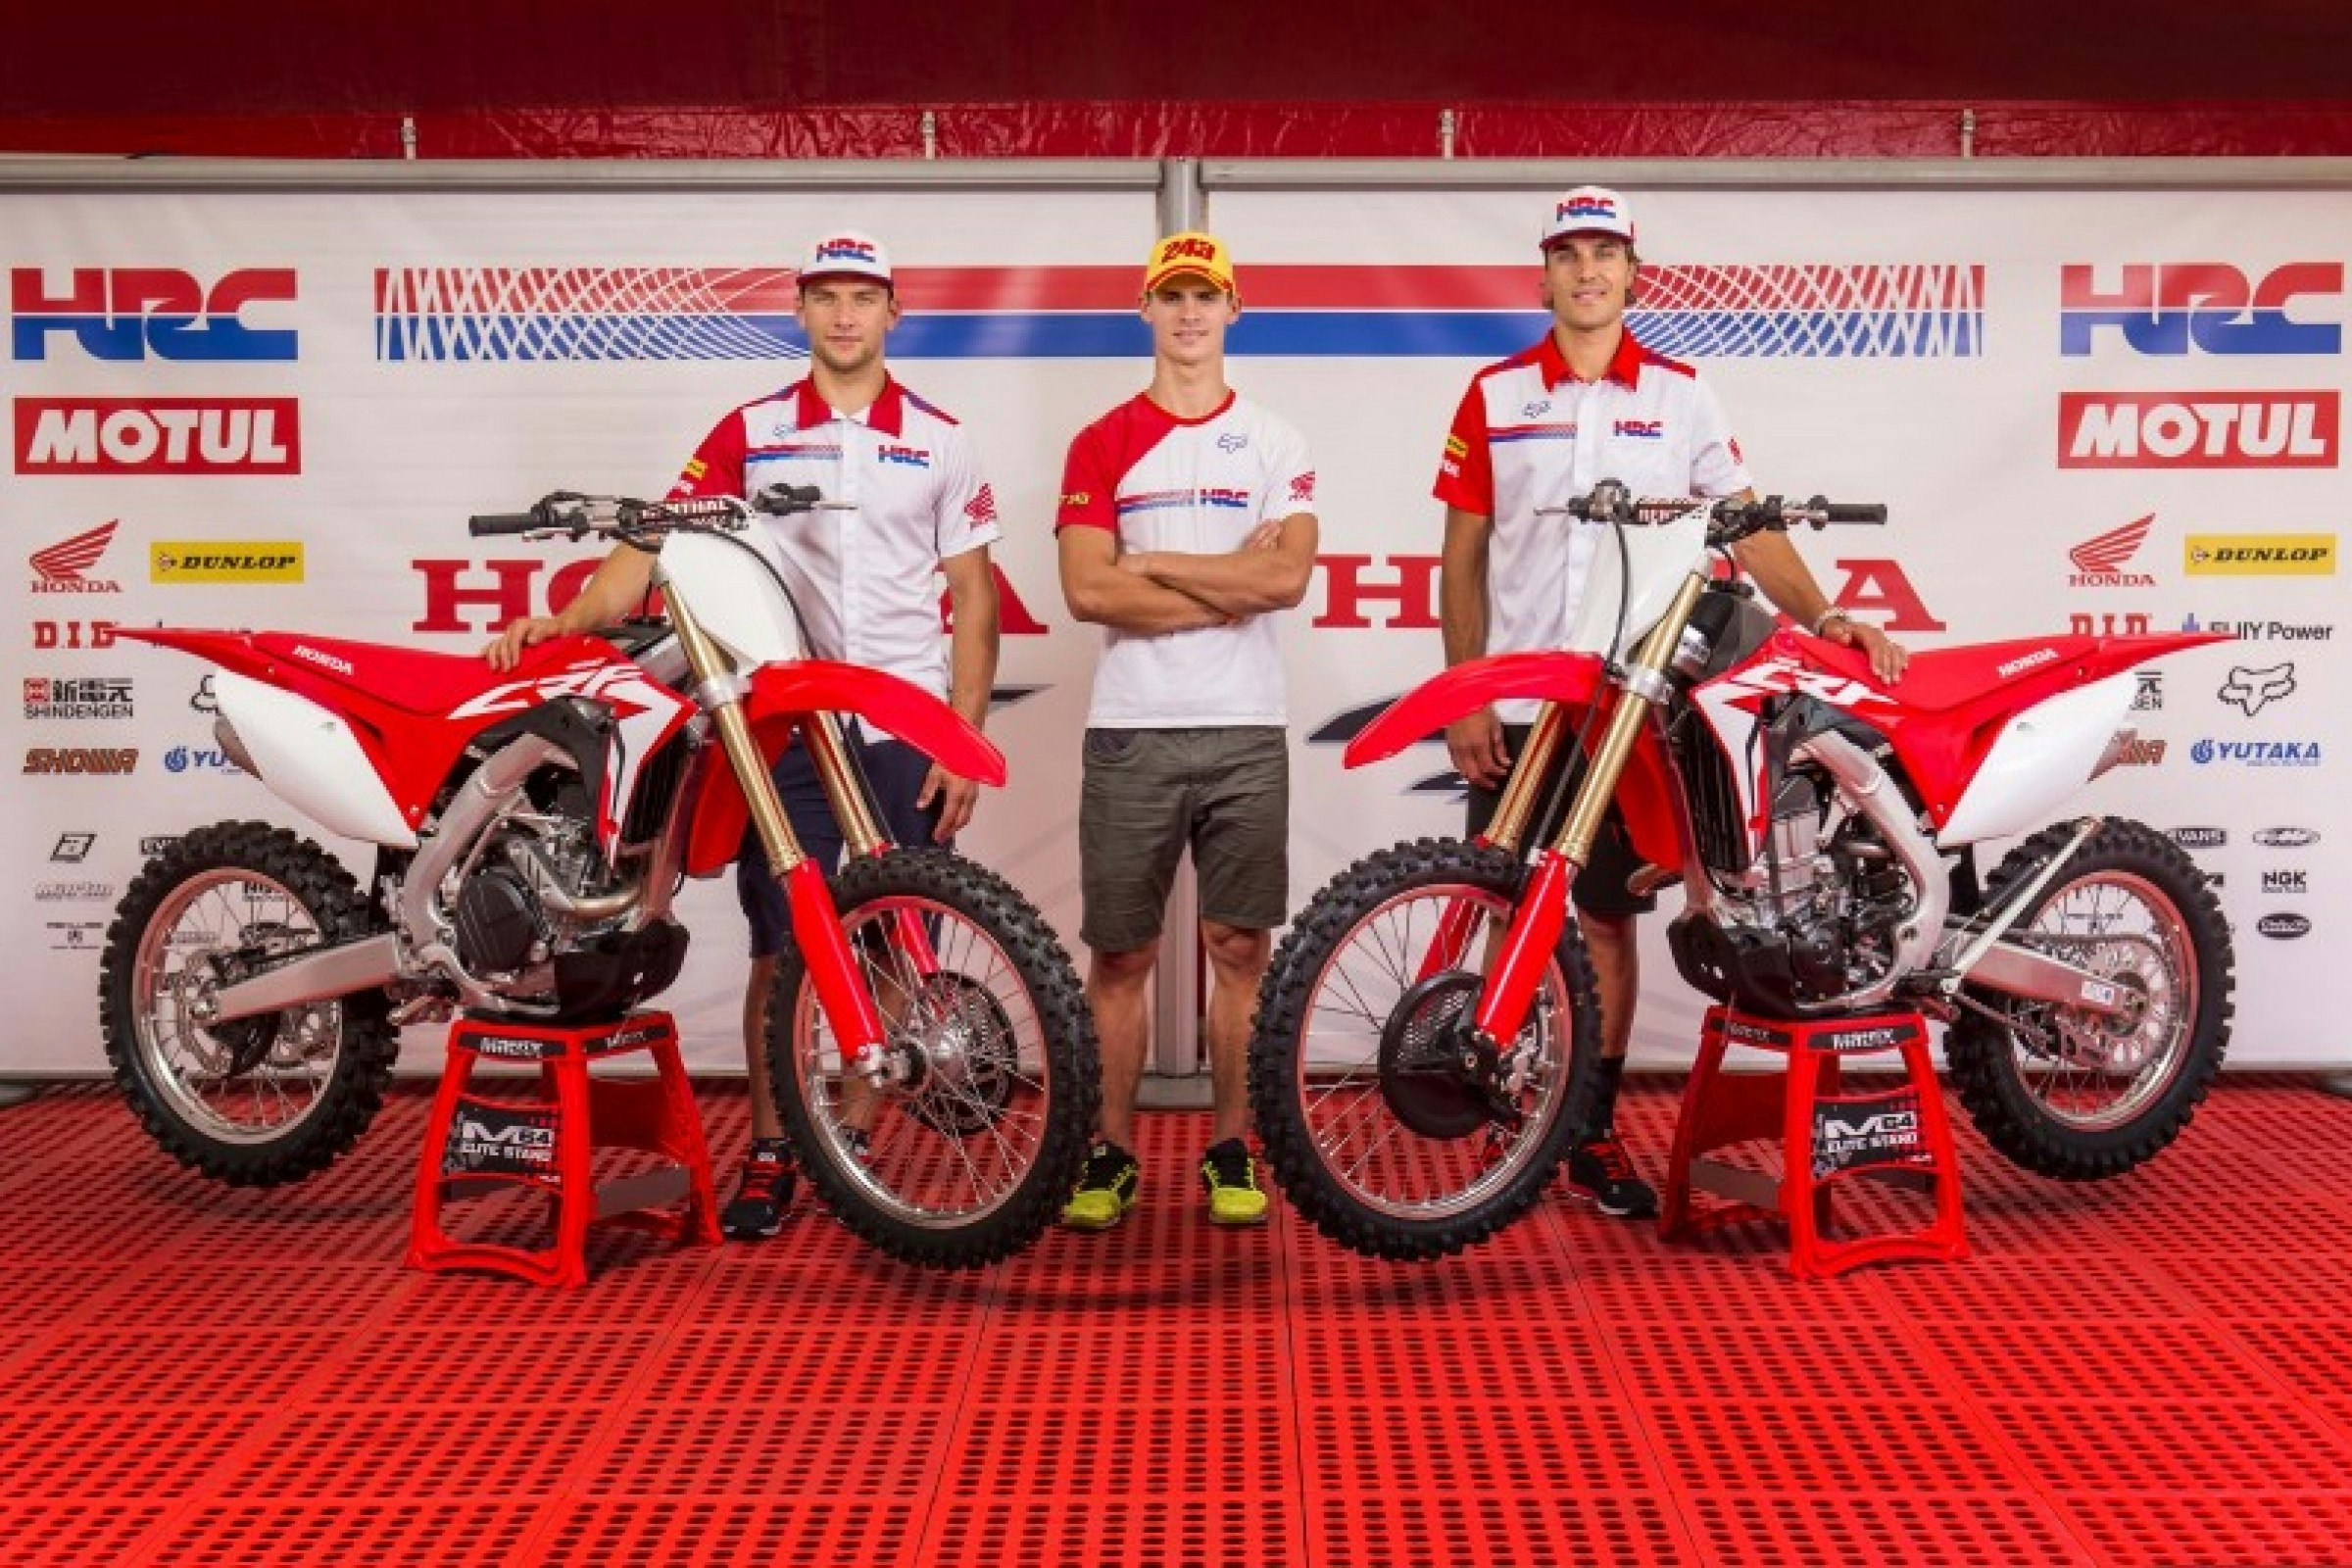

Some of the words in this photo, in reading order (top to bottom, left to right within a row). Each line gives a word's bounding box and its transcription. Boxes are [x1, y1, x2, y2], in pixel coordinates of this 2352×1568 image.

[1556, 197, 1616, 221] HRC
[816, 239, 875, 263] HRC
[12, 268, 298, 362] HRC
[2060, 263, 2343, 356] HRC
[26, 409, 287, 464] MOTUL
[1613, 420, 1663, 438] HRC
[2069, 403, 2328, 458] MOTUL
[878, 444, 929, 468] HRC
[180, 556, 296, 569] DUNLOP
[2214, 548, 2328, 562] DUNLOP
[31, 580, 123, 593] HONDA
[2069, 574, 2156, 587] HONDA
[2267, 621, 2333, 640] Power
[292, 645, 353, 675] HONDA
[1996, 647, 2059, 678] HONDA
[23, 704, 133, 719] SHINDENGEN
[22, 748, 139, 774] SHOWA
[2218, 742, 2321, 759] YUTAKA
[2262, 871, 2307, 886] NGK
